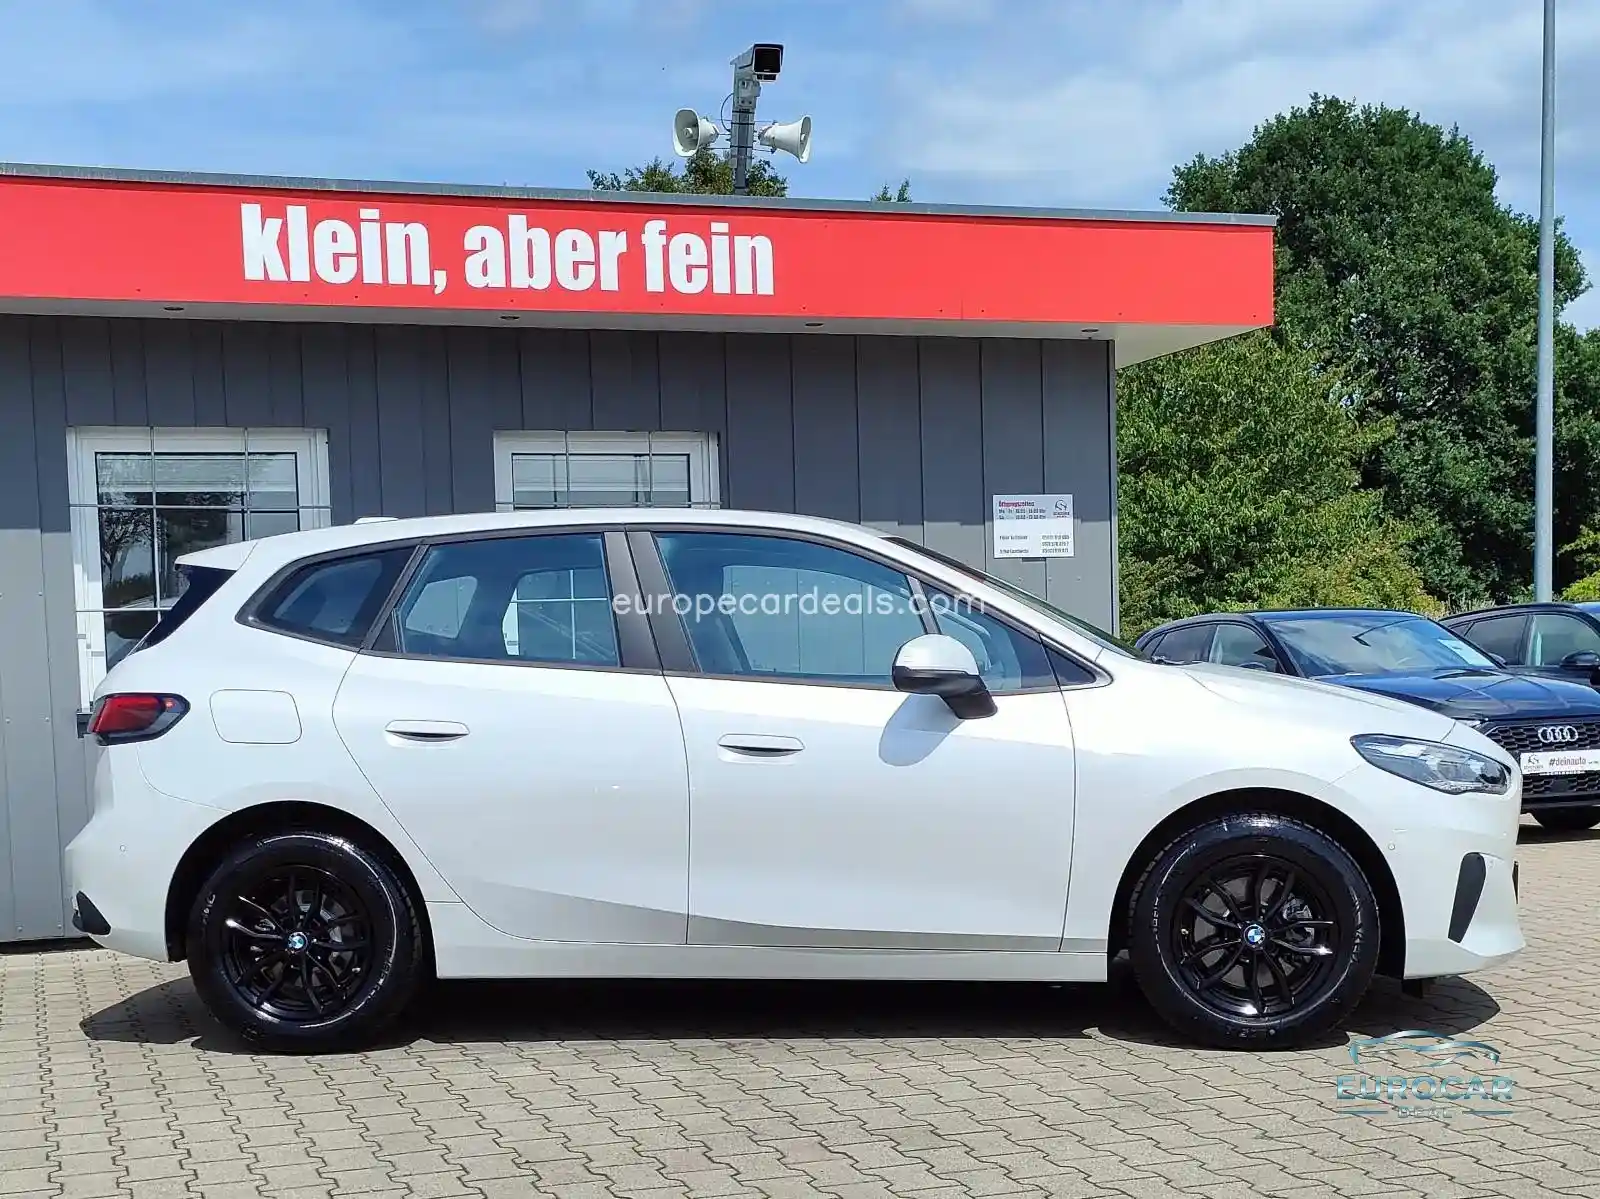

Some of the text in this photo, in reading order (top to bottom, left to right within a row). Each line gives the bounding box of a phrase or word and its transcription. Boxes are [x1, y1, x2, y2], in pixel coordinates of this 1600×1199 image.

[240, 202, 776, 296] klein, aber fein
